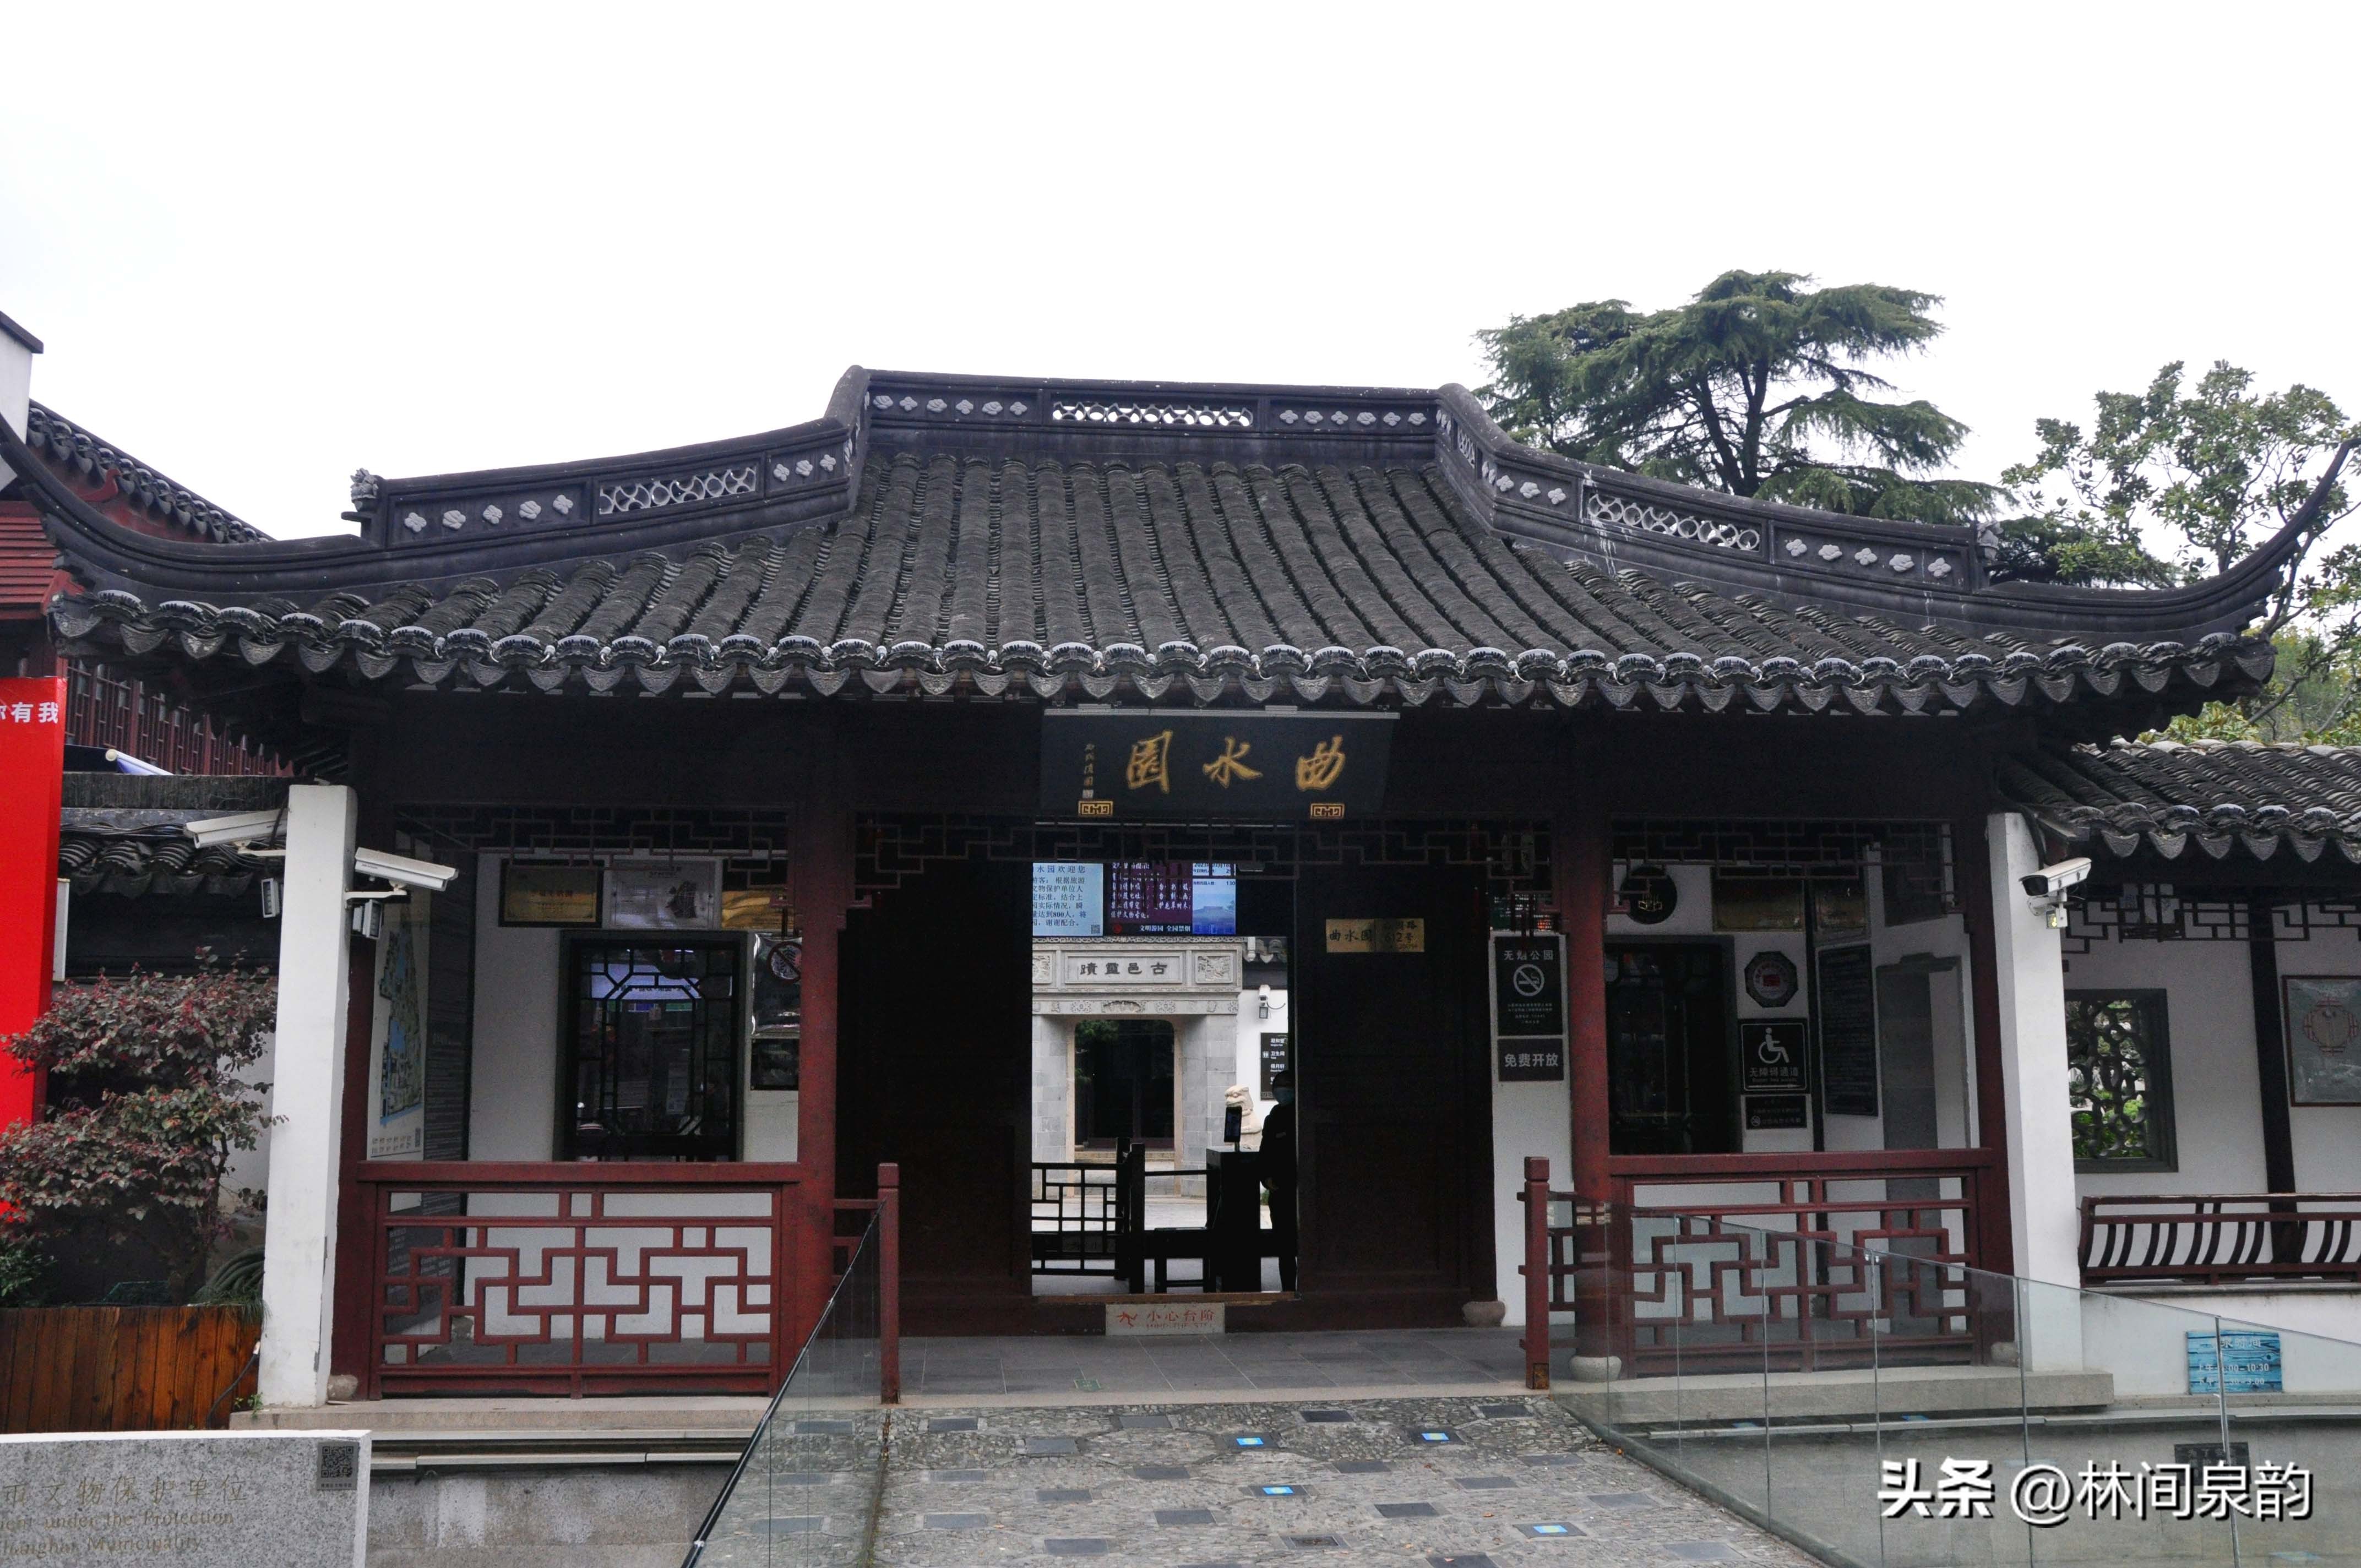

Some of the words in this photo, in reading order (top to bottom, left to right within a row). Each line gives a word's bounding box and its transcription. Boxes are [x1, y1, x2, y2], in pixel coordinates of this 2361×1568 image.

[1032, 865, 1086, 873] 水园欢迎您
[1504, 949, 1554, 961] 无烟公园
[1504, 1052, 1559, 1068] 免费开放
[1749, 1066, 1799, 1077] 无障碍通道
[1147, 1309, 1215, 1322] 小心台阶
